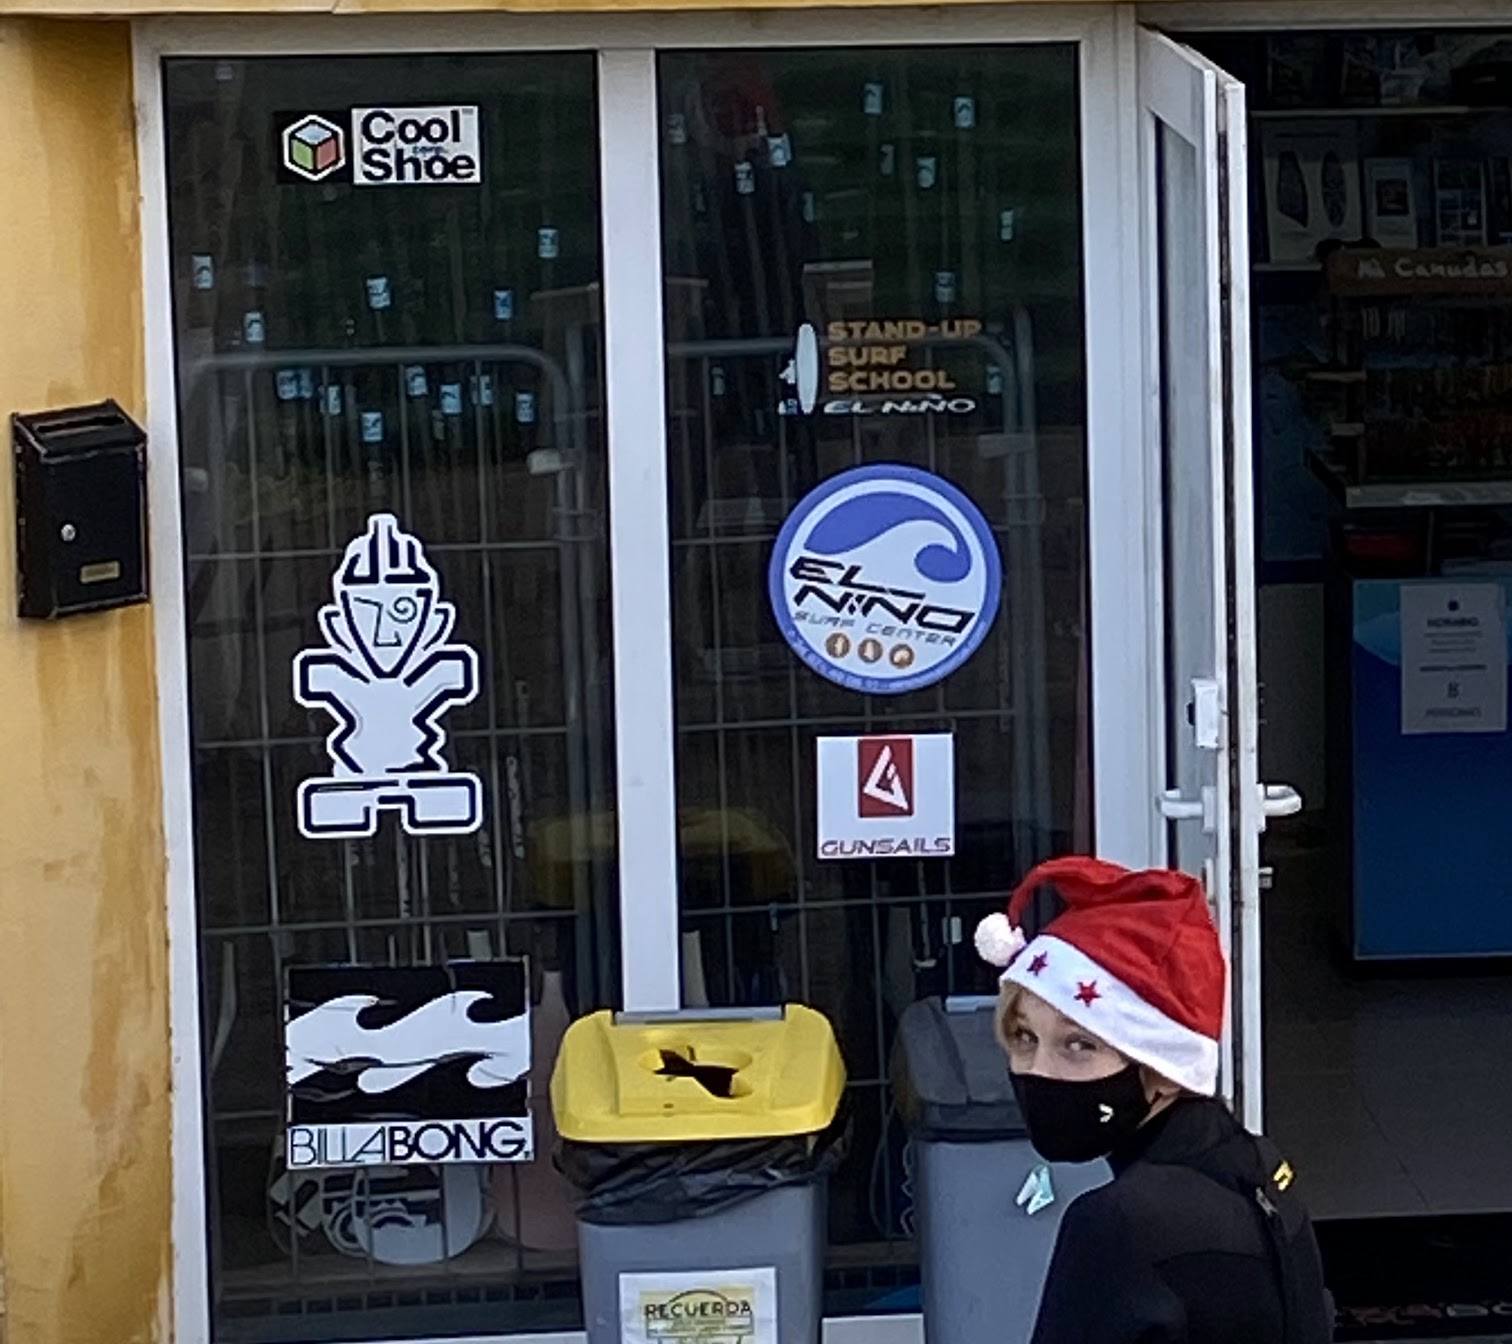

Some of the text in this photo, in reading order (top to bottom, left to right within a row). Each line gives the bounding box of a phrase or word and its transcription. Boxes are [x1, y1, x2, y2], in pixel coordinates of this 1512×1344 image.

[361, 109, 461, 145] Cool
[361, 147, 476, 181] Shoe
[827, 319, 982, 342] STAND-UP
[827, 345, 908, 367] SURF
[827, 370, 956, 392] SCHOOL
[790, 555, 889, 594] EL
[865, 621, 957, 646] CENTER
[821, 837, 952, 856] GUNSAILS
[290, 1120, 528, 1165] BILLABONG
[643, 1299, 753, 1321] RECUERDA
